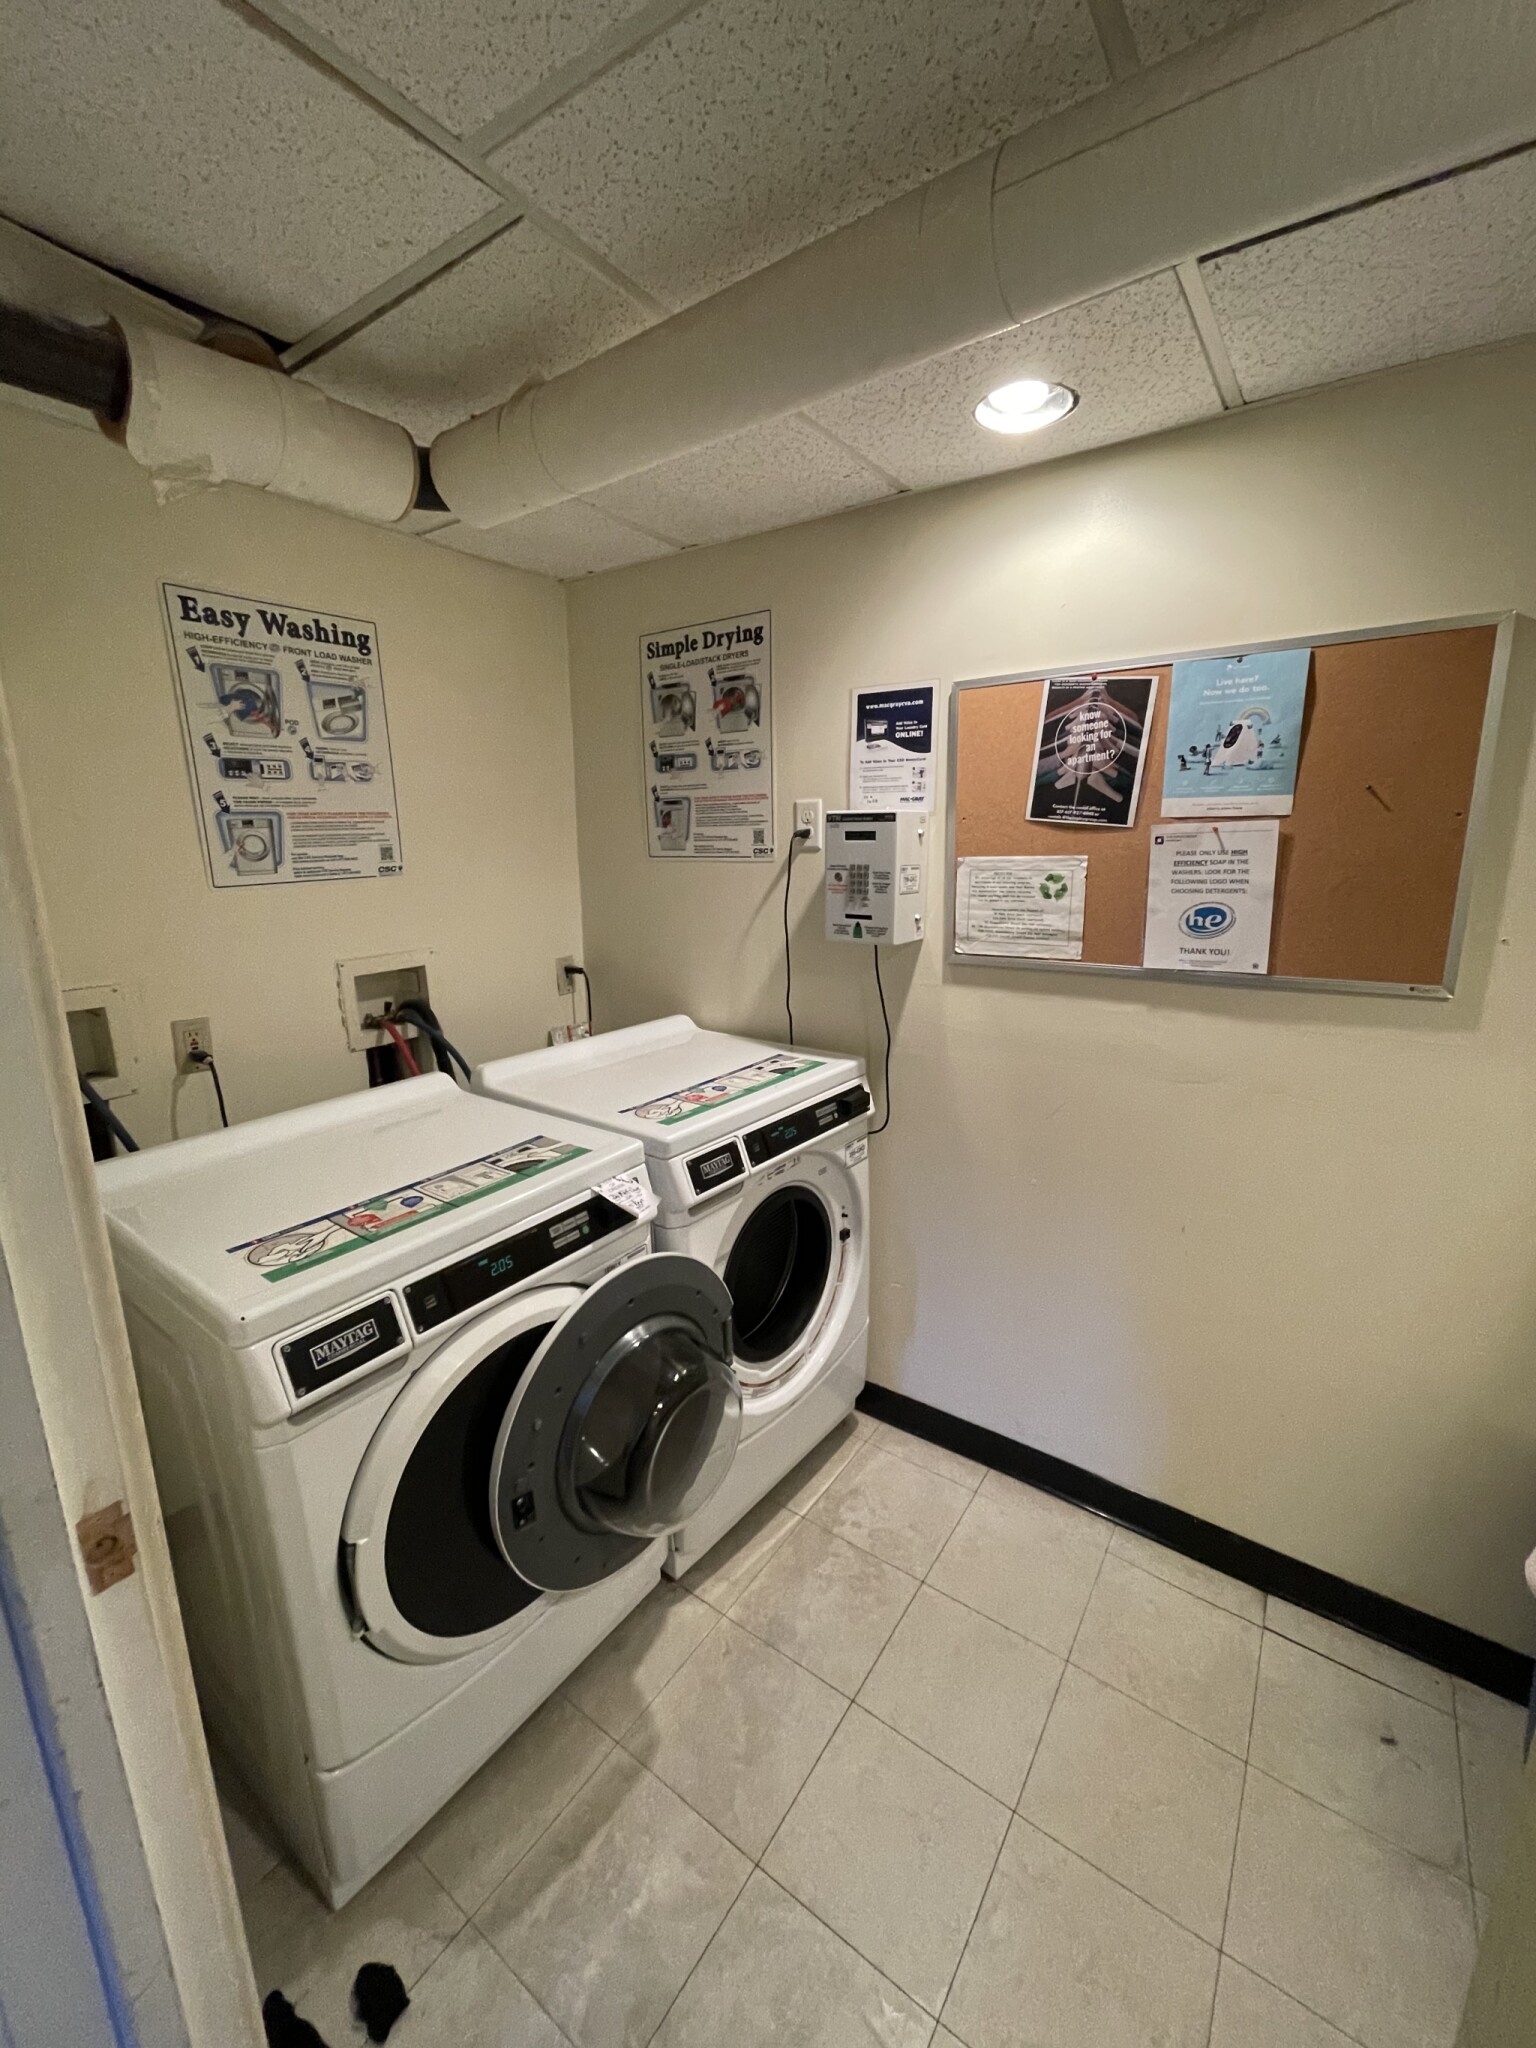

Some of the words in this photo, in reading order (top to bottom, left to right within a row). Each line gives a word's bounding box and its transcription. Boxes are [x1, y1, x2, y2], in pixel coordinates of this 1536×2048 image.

[177, 595, 250, 638] Easy
[256, 608, 372, 656] Washing
[183, 631, 268, 650] HIGH-EFFICIENCY
[282, 645, 311, 658] FRONT
[314, 651, 338, 662] LOAD
[339, 654, 373, 666] WASHER
[647, 634, 698, 660] Simple
[702, 625, 764, 650] Drying
[722, 650, 749, 660] DRYERS
[1234, 674, 1260, 685] here?
[1202, 688, 1222, 697] Now
[1079, 711, 1102, 721] know
[1072, 720, 1109, 733] someone
[895, 730, 924, 738] ONLINE!
[1069, 732, 1099, 744] looking
[1100, 729, 1113, 740] for
[1085, 743, 1096, 752] an
[1067, 749, 1116, 766] apartment?
[378, 865, 397, 873] CSC
[1188, 908, 1223, 929] he
[1179, 947, 1207, 955] THANK
[702, 1156, 731, 1173] MAYTAG
[314, 1322, 374, 1361] MAYTAG
